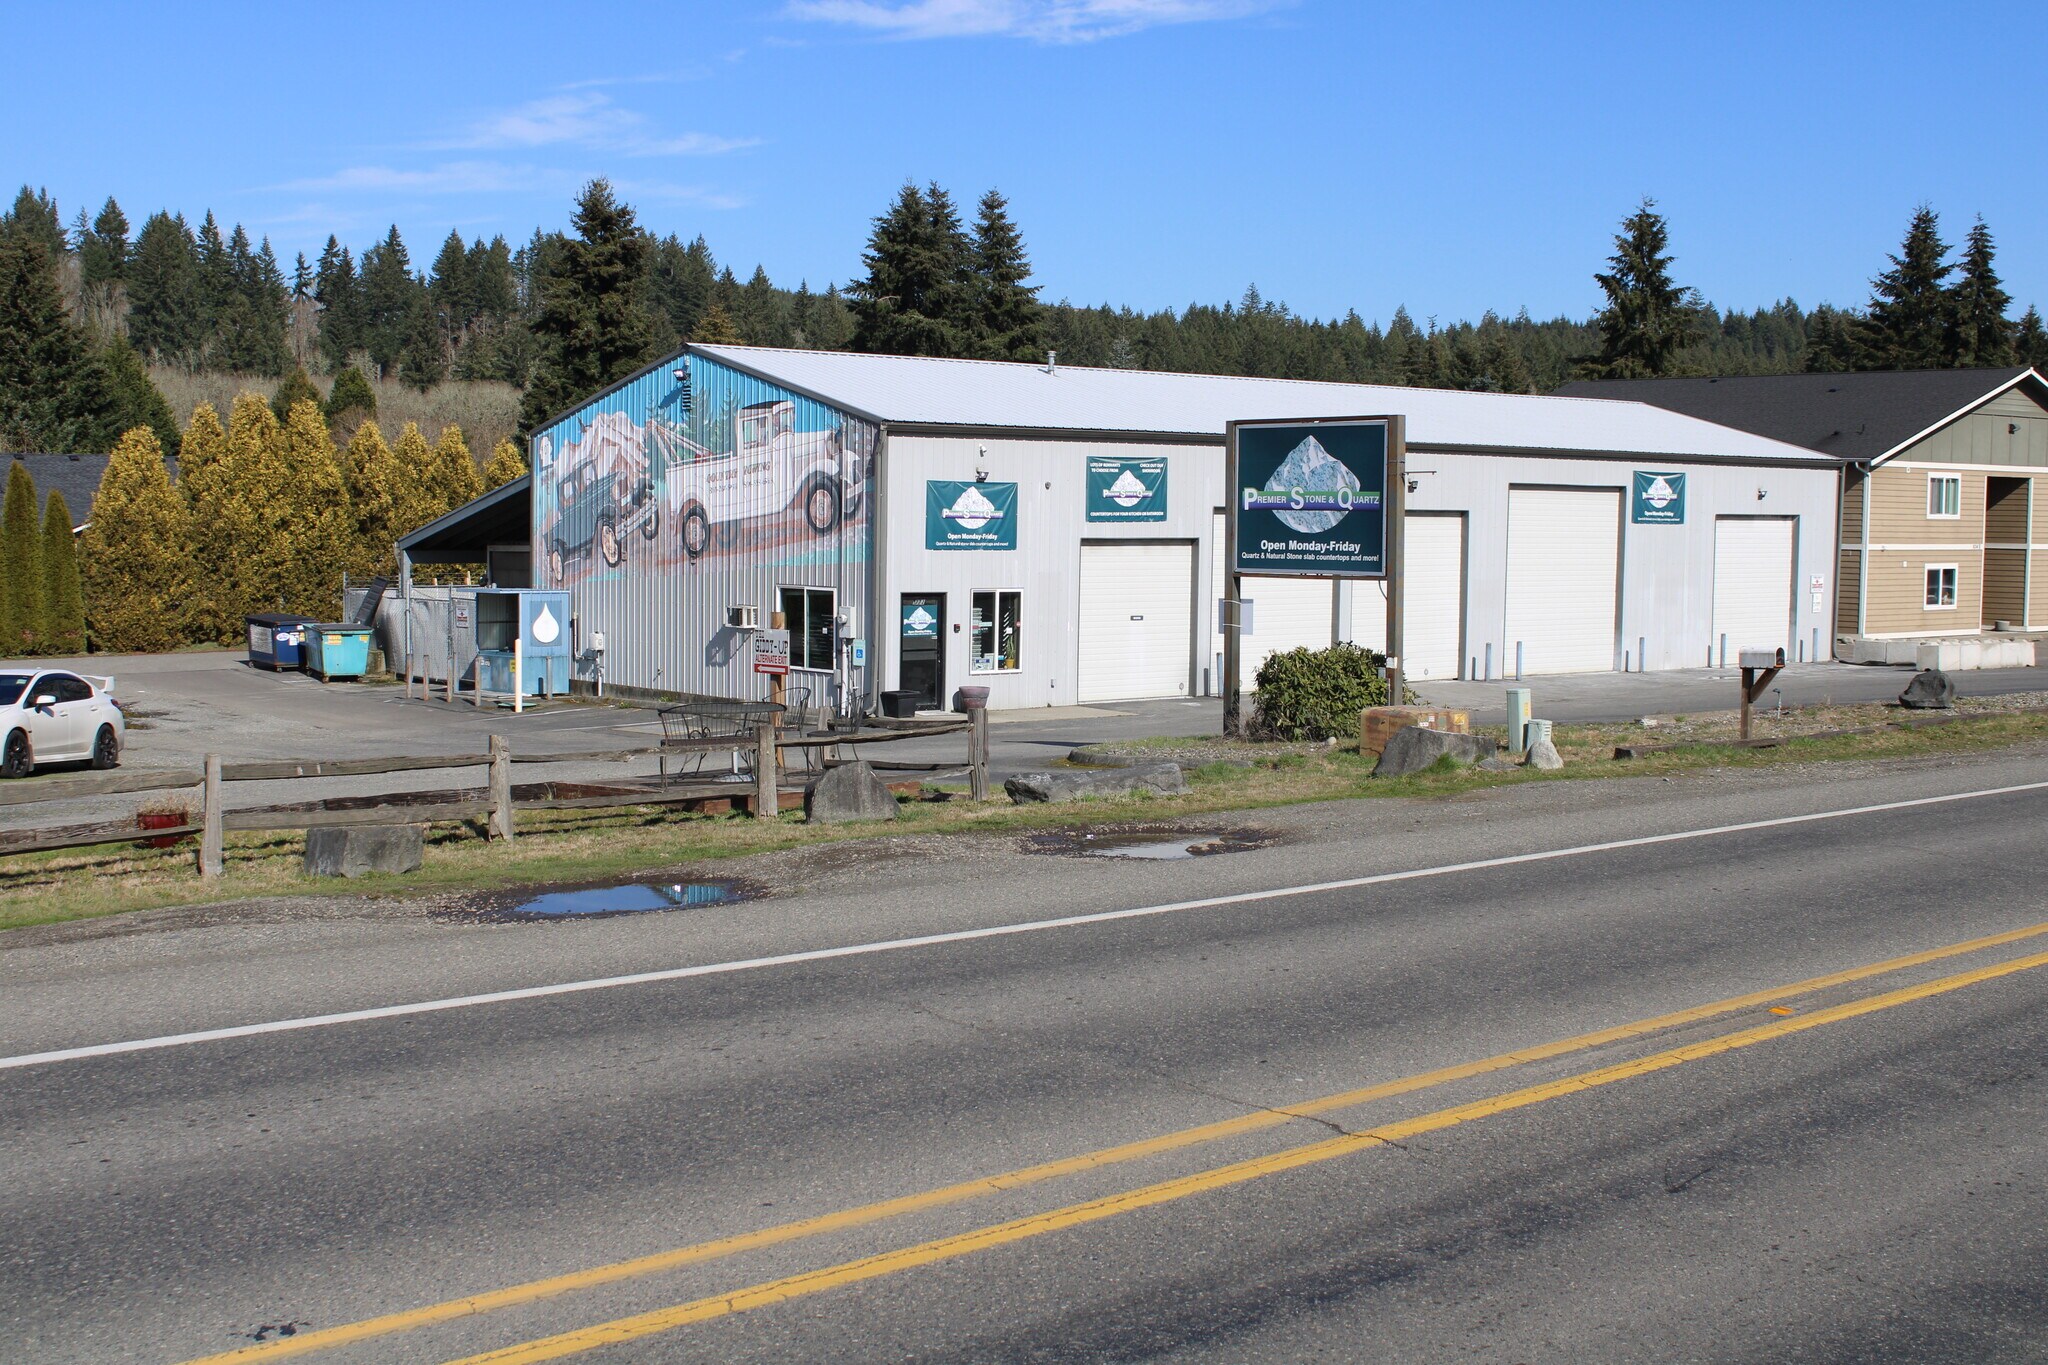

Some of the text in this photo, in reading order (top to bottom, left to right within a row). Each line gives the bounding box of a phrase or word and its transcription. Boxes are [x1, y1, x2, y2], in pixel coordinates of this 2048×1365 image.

[1244, 488, 1286, 510] PREMIER
[1290, 487, 1326, 510] STONE
[1338, 487, 1379, 510] QUARTZ
[1261, 540, 1360, 553] Open Monday-Friday
[755, 639, 788, 654] GIDDY-UP
